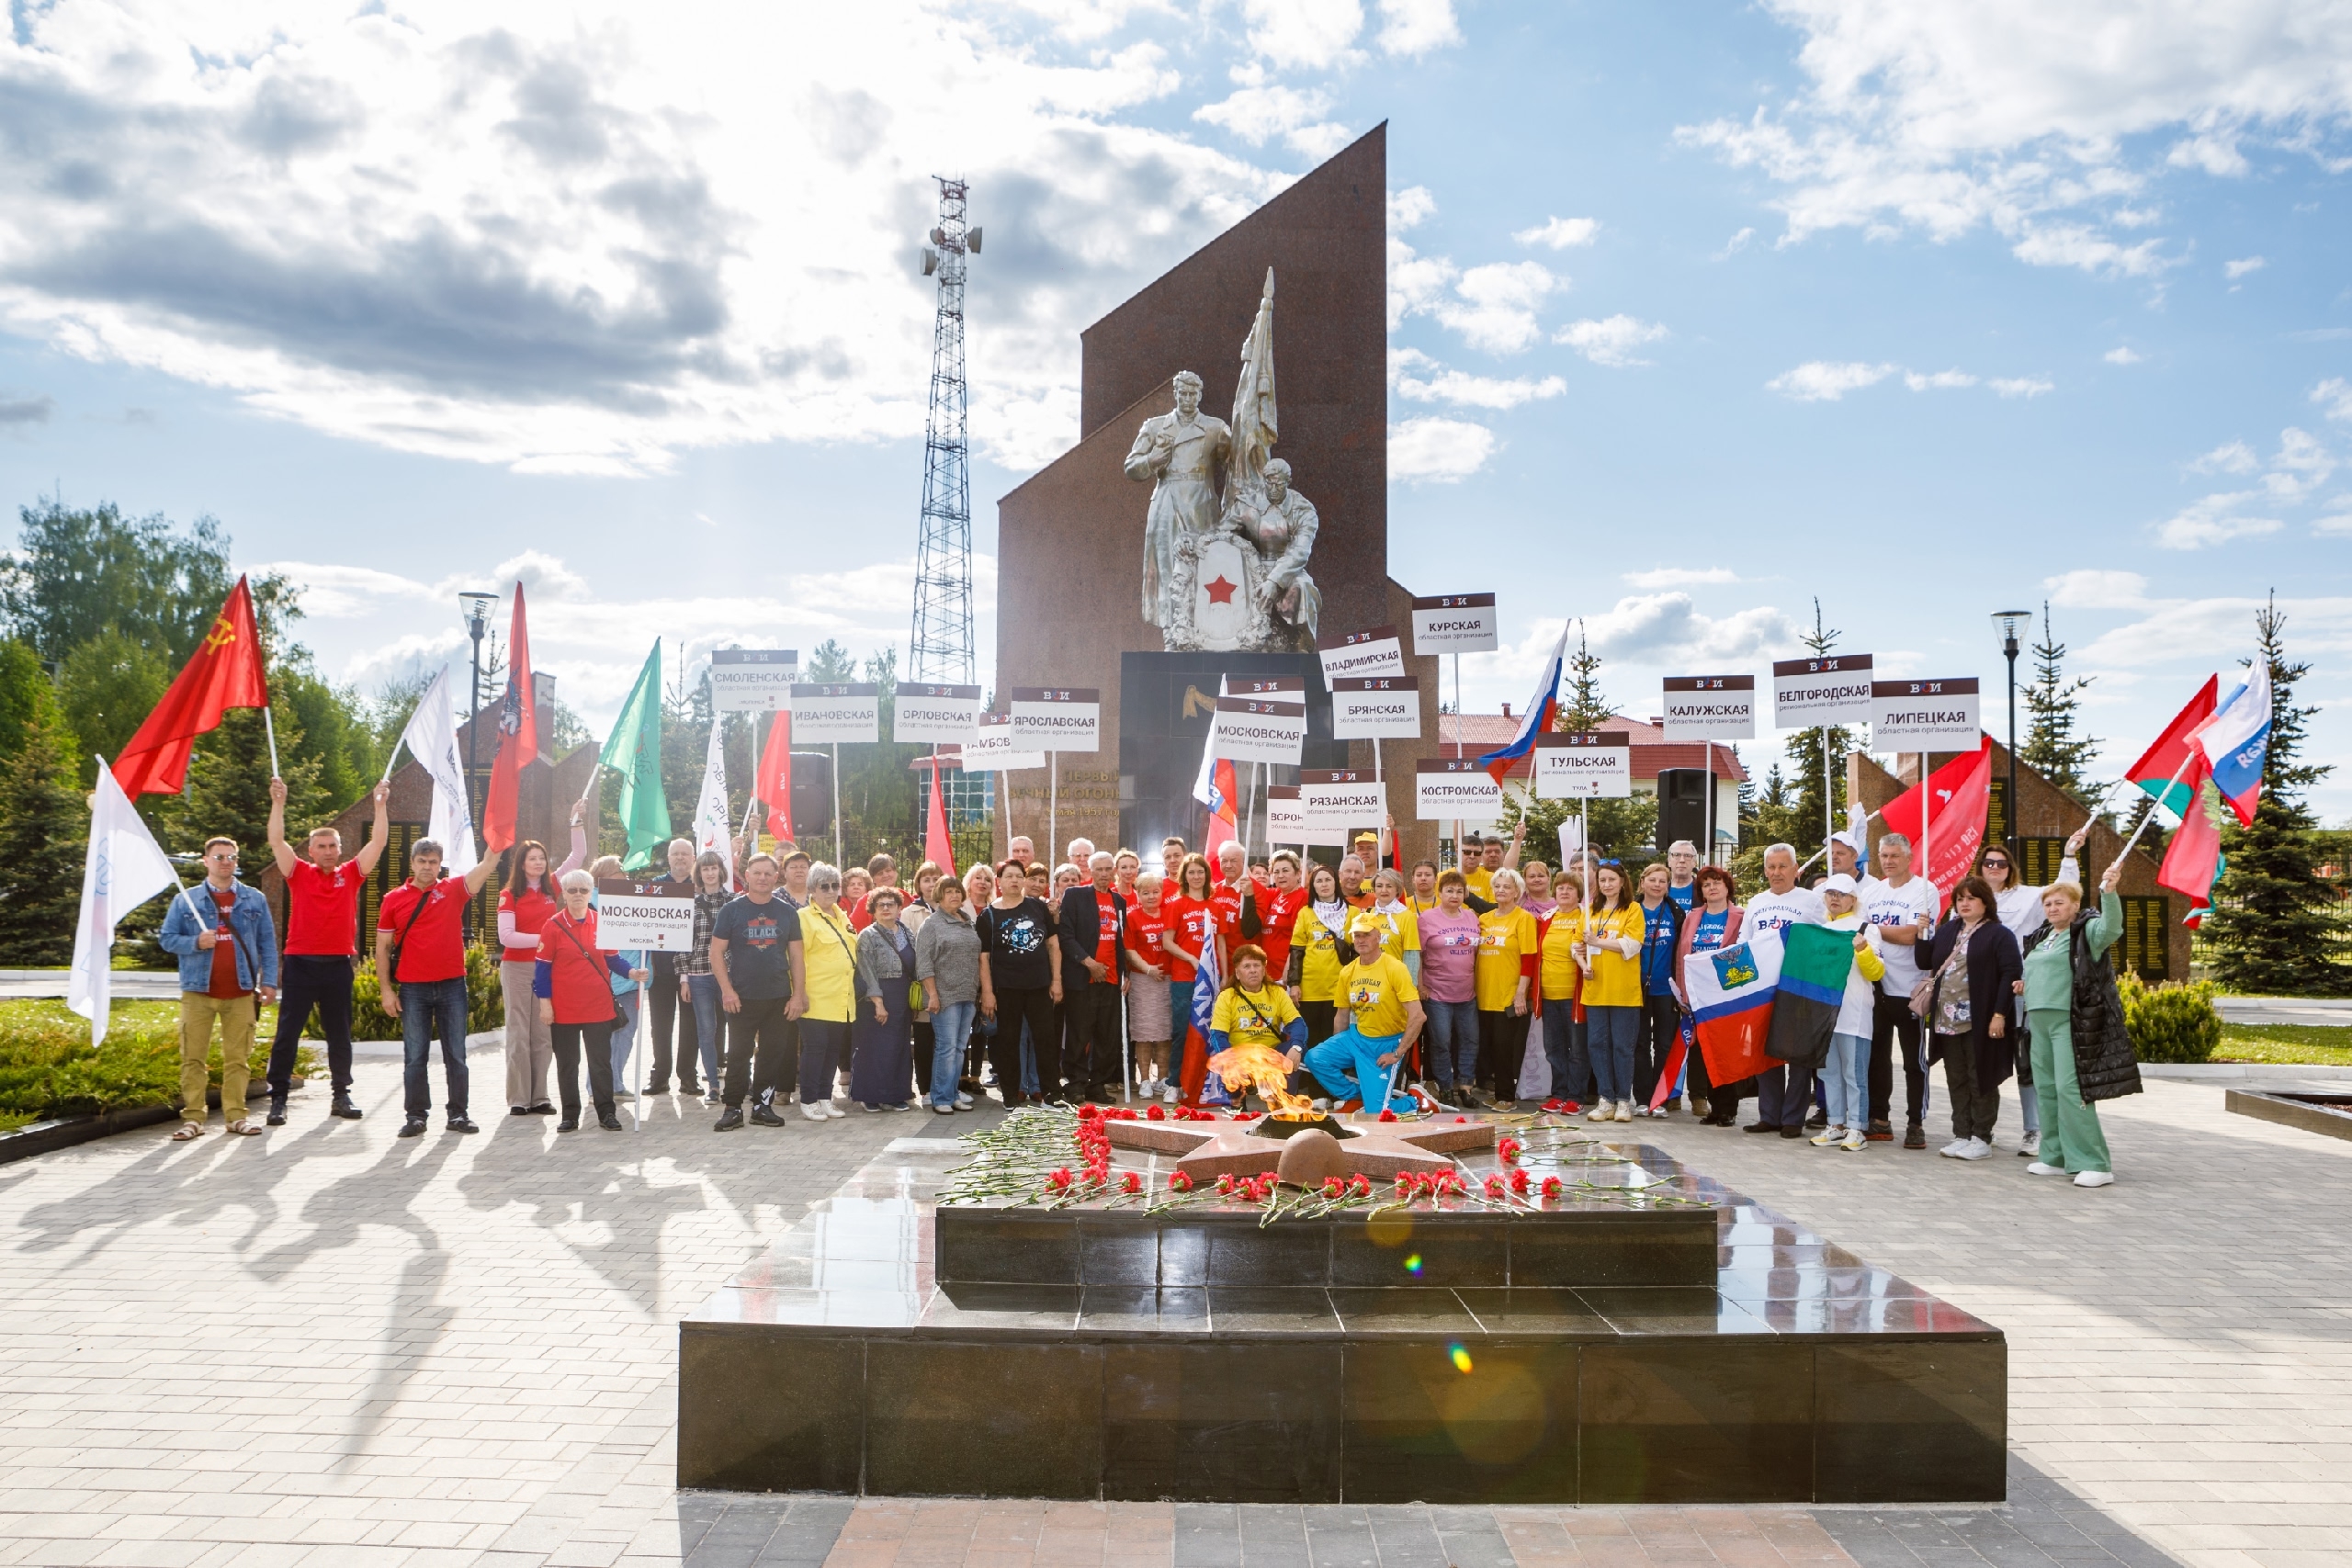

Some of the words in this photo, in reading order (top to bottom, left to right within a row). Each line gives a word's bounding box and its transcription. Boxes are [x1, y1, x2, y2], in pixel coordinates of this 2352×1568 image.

[1429, 620, 1481, 632] КУРСКАЯ
[1453, 632, 1493, 640] организация
[1325, 650, 1399, 672] ВЛАДИМИРСКАЯ
[714, 672, 796, 682] СМОЛЕНСКАЯ
[1779, 684, 1870, 703] БЕЛГОРОДСКАЯ
[1348, 705, 1406, 716] БРЯНСКАЯ
[1669, 705, 1749, 716] КАЛУЖСКАЯ
[1779, 701, 1826, 712] региональная
[1826, 698, 1871, 708] организация
[795, 710, 875, 721] ИВАНОВСКАЯ
[903, 710, 972, 722] ОРЛОВСКАЯ
[1885, 711, 1966, 725] ЛИПЕЦКАЯ
[1014, 716, 1096, 728] ЯРОСЛАВСКАЯ
[1217, 725, 1300, 741] МОСКОВСКАЯ
[1877, 727, 1920, 735] областная
[1921, 726, 1974, 734] организация
[1218, 738, 1254, 747] областная
[1254, 740, 1297, 750] организация
[1549, 756, 1616, 767] ТУЛЬСКАЯ
[1421, 785, 1498, 795] КОСТРОМСКАЯ
[1309, 795, 1378, 807] РЯЗАНСКАЯ
[1056, 807, 1076, 816] мая
[1079, 807, 1103, 816] 1957
[1271, 812, 1303, 822] ВОРОН
[1340, 807, 1378, 816] организаци
[601, 905, 691, 919] МОСКОВСКАЯ
[642, 921, 688, 930] организация
[748, 927, 777, 938] BLACK
